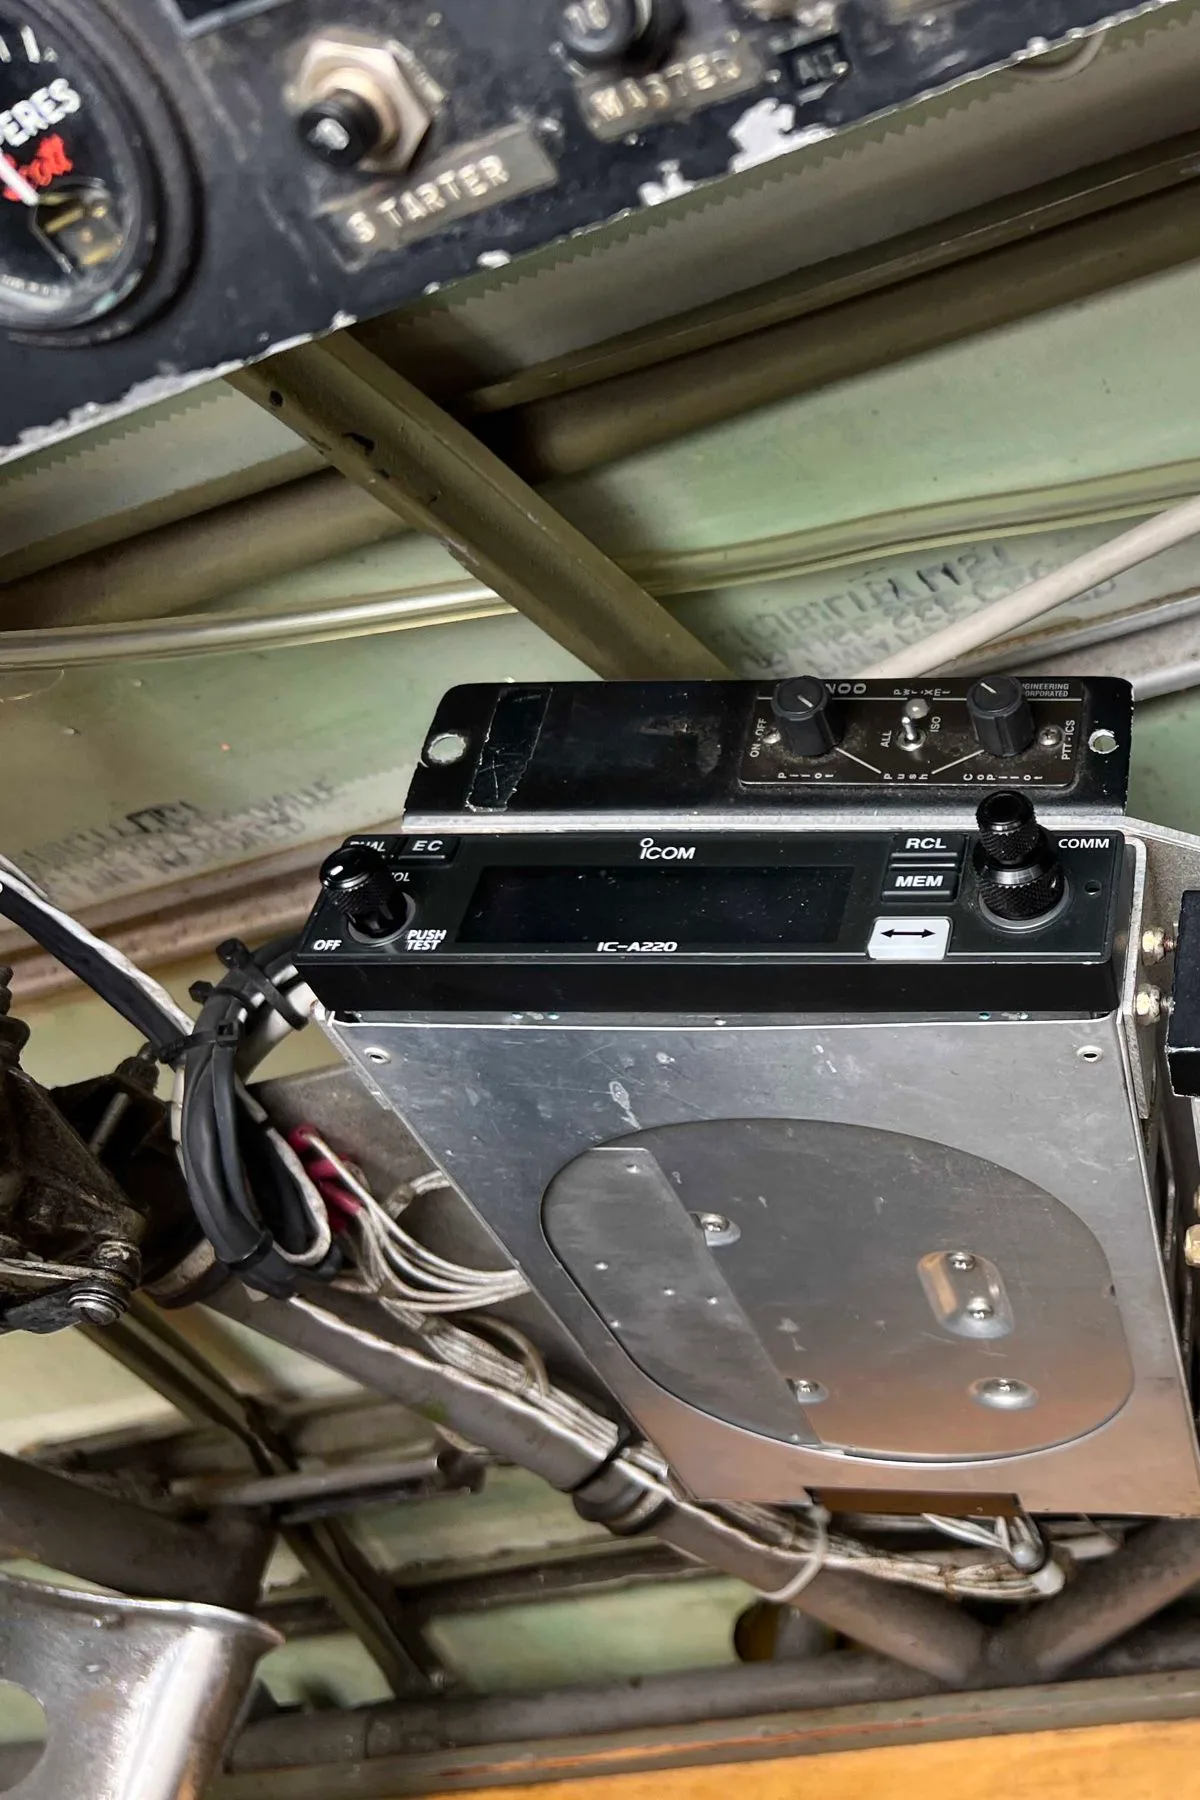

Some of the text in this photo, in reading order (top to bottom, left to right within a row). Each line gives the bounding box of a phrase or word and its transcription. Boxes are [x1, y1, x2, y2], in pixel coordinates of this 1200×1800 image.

[589, 51, 742, 122] MASTER
[0, 78, 81, 147] ERES
[347, 155, 511, 243] STARTER
[930, 716, 942, 732] ISO
[880, 730, 892, 748] ALL
[412, 840, 443, 851] EC
[905, 837, 947, 850] RCL
[1057, 838, 1110, 849] COMM
[391, 871, 411, 882] OL
[894, 875, 944, 890] MEM
[407, 929, 447, 940] PUSH
[313, 939, 342, 951] OFF
[407, 940, 441, 951] TEST
[597, 941, 678, 953] IC-A220
